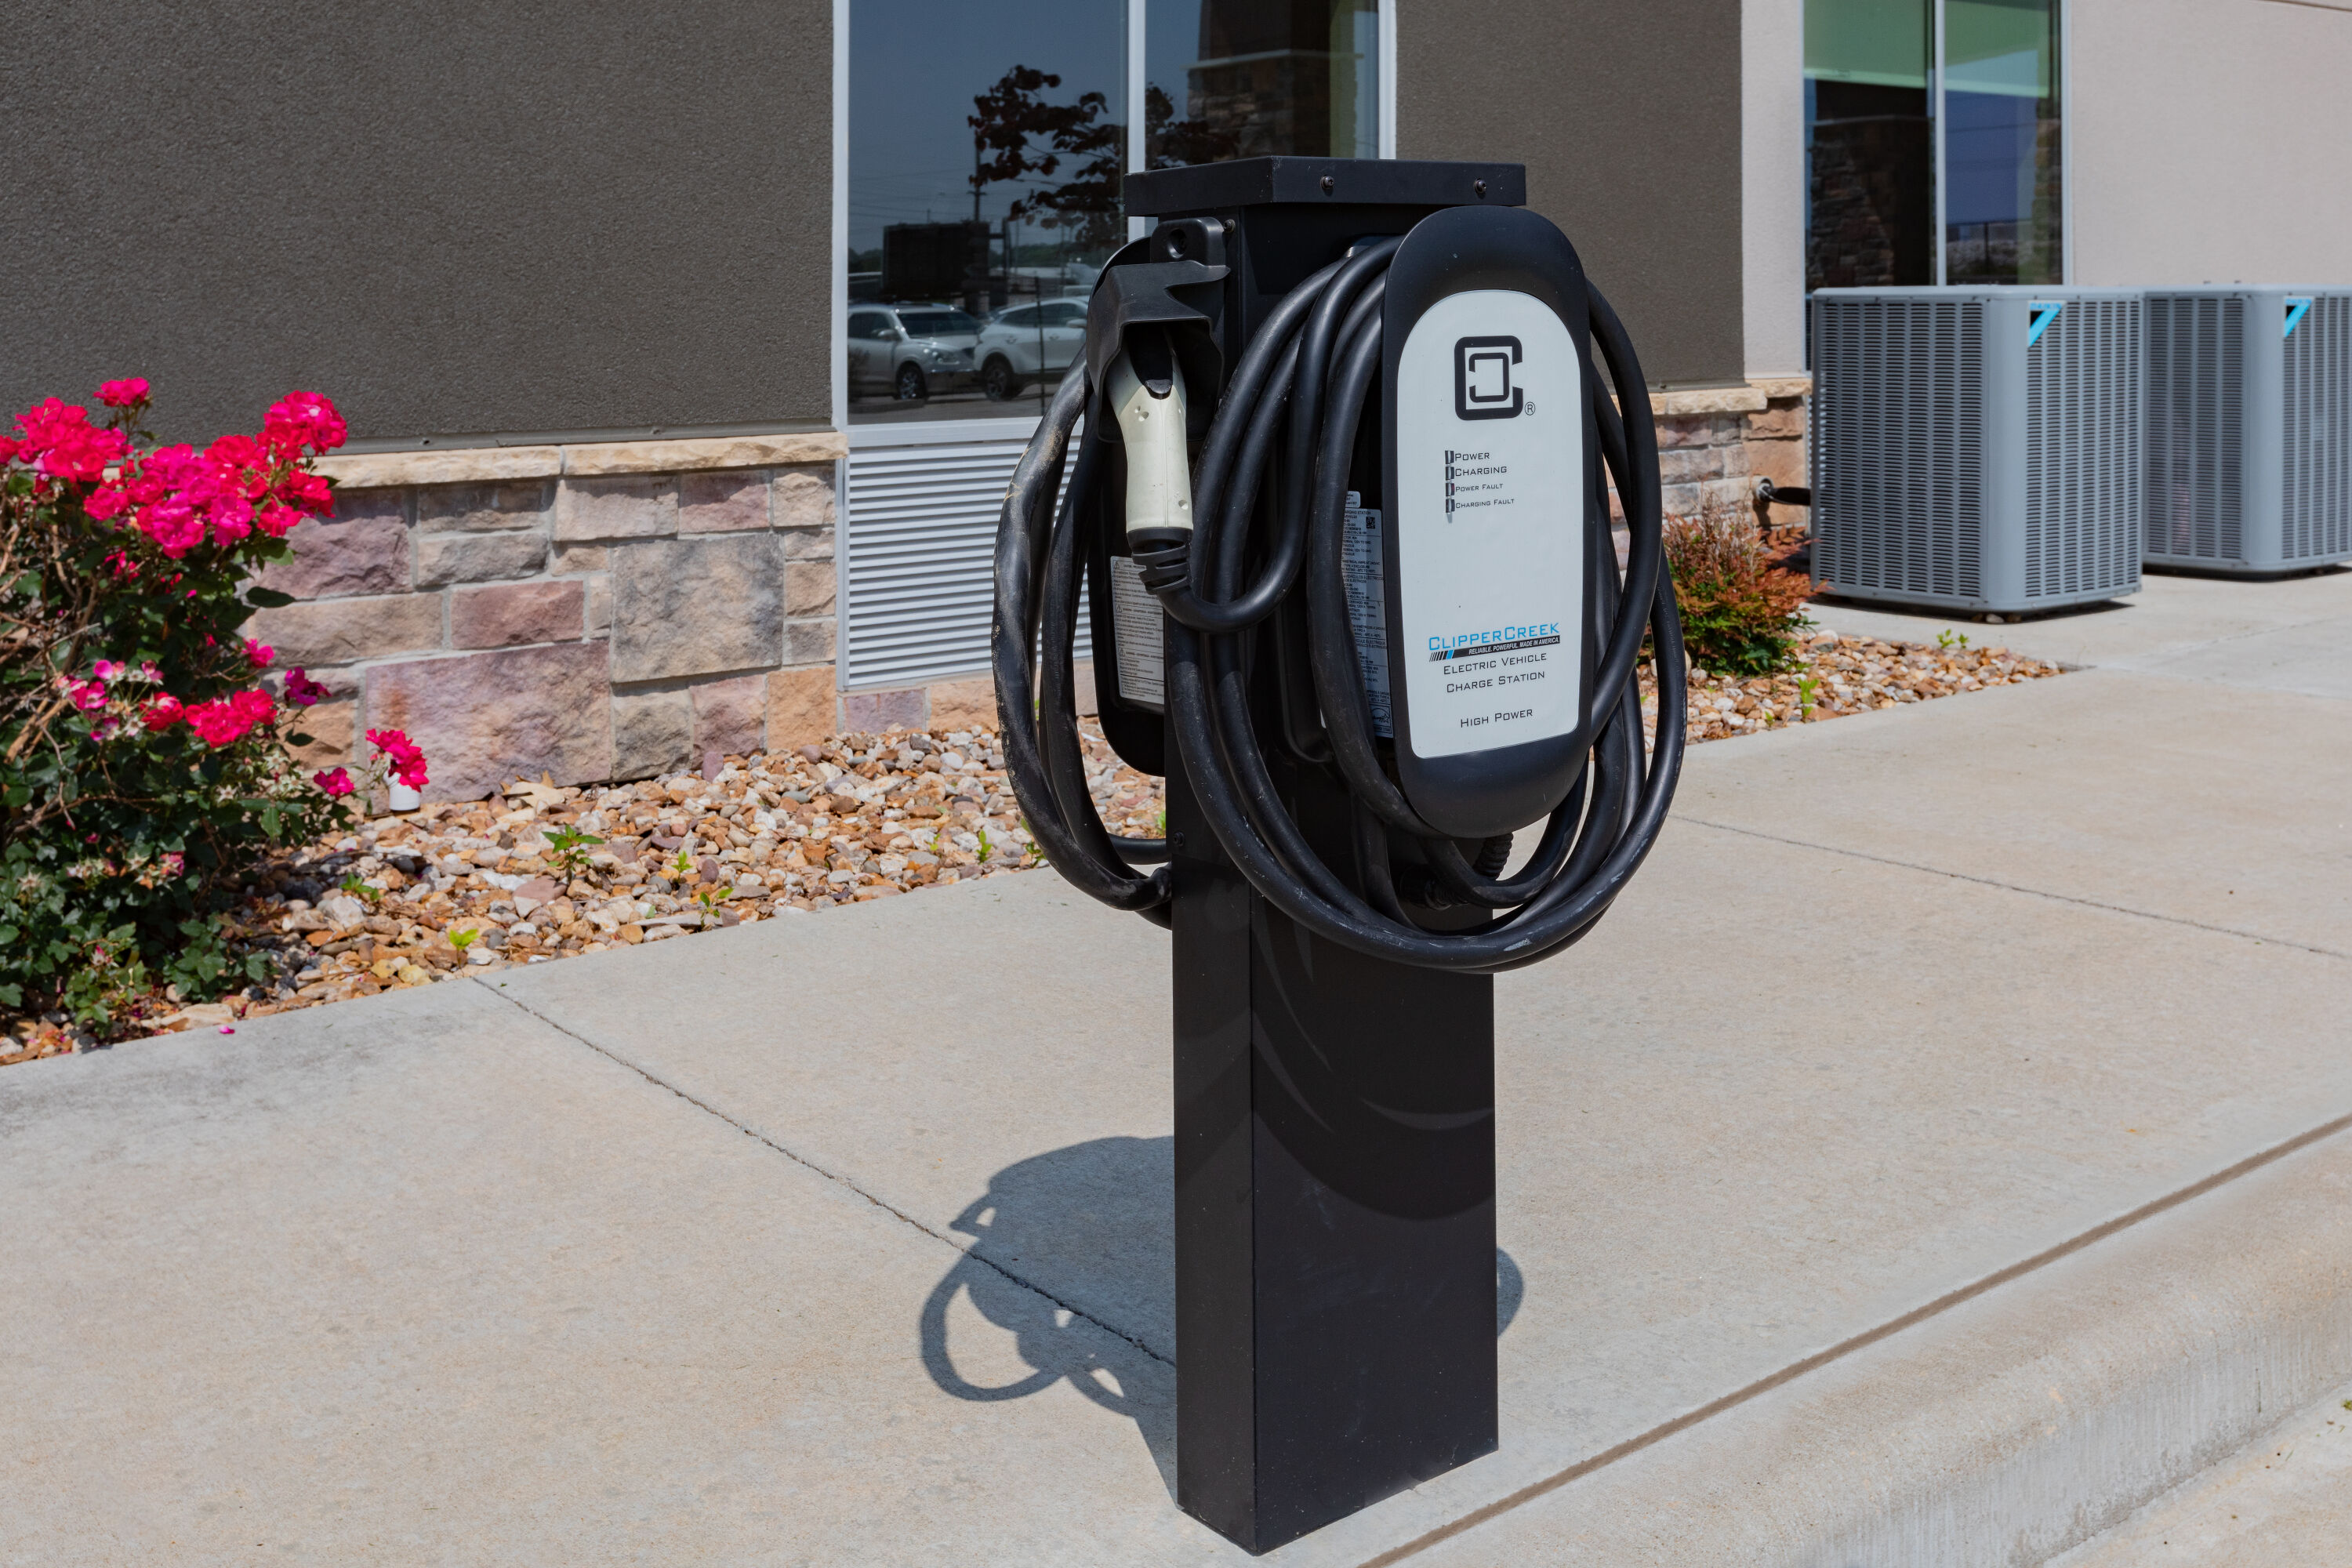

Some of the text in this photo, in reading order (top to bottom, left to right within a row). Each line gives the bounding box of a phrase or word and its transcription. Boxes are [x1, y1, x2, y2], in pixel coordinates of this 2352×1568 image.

[1468, 646, 1493, 655] RELIABLE.
[1493, 642, 1519, 652] POWERFUL.
[1519, 640, 1534, 648] MADE
